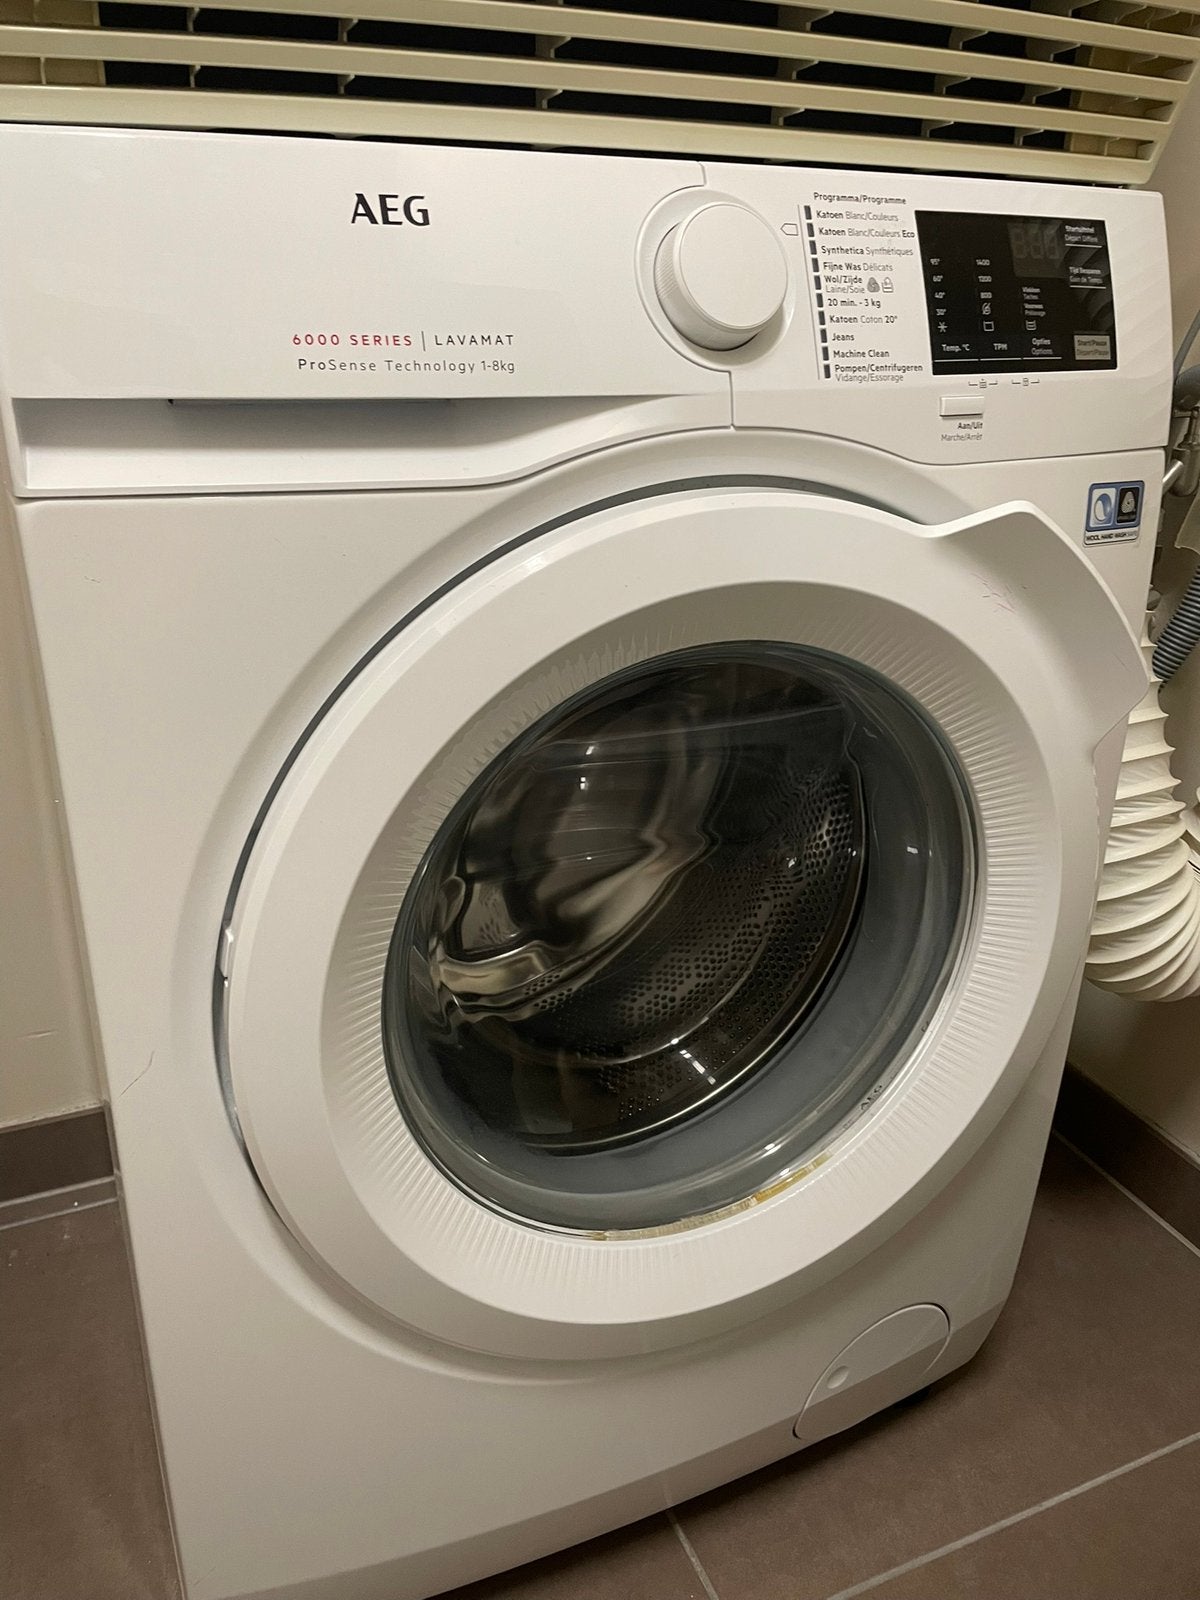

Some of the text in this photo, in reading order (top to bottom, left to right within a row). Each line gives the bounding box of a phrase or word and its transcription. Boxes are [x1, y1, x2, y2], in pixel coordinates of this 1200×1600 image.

[814, 192, 906, 205] Programma/Programme
[351, 193, 430, 227] AEG
[816, 210, 899, 222] Katoen Blanc/Couleurs
[818, 227, 915, 238] Katoen Blanc/Couleurs Eco
[821, 245, 864, 255] Synthetica
[823, 262, 843, 272] Fijne
[844, 263, 862, 271] Was
[824, 275, 863, 285] Wol/Zijde
[826, 285, 865, 294] Laine/Soie
[828, 298, 838, 306] 20
[840, 298, 858, 306] min.
[864, 298, 869, 306] 3
[871, 298, 881, 308] kg
[830, 315, 898, 324] Katoen Coton 20°
[292, 334, 514, 346] 6000 SERIES LAVAMAT
[832, 333, 855, 341] Jeans
[993, 343, 1008, 351] TPM
[833, 349, 890, 358] Machine Clean
[298, 358, 515, 374] ProSense Technology 1-8kg
[834, 363, 923, 373] Pompen/Centrifugeren
[836, 373, 904, 384] Vidange/Essorage
